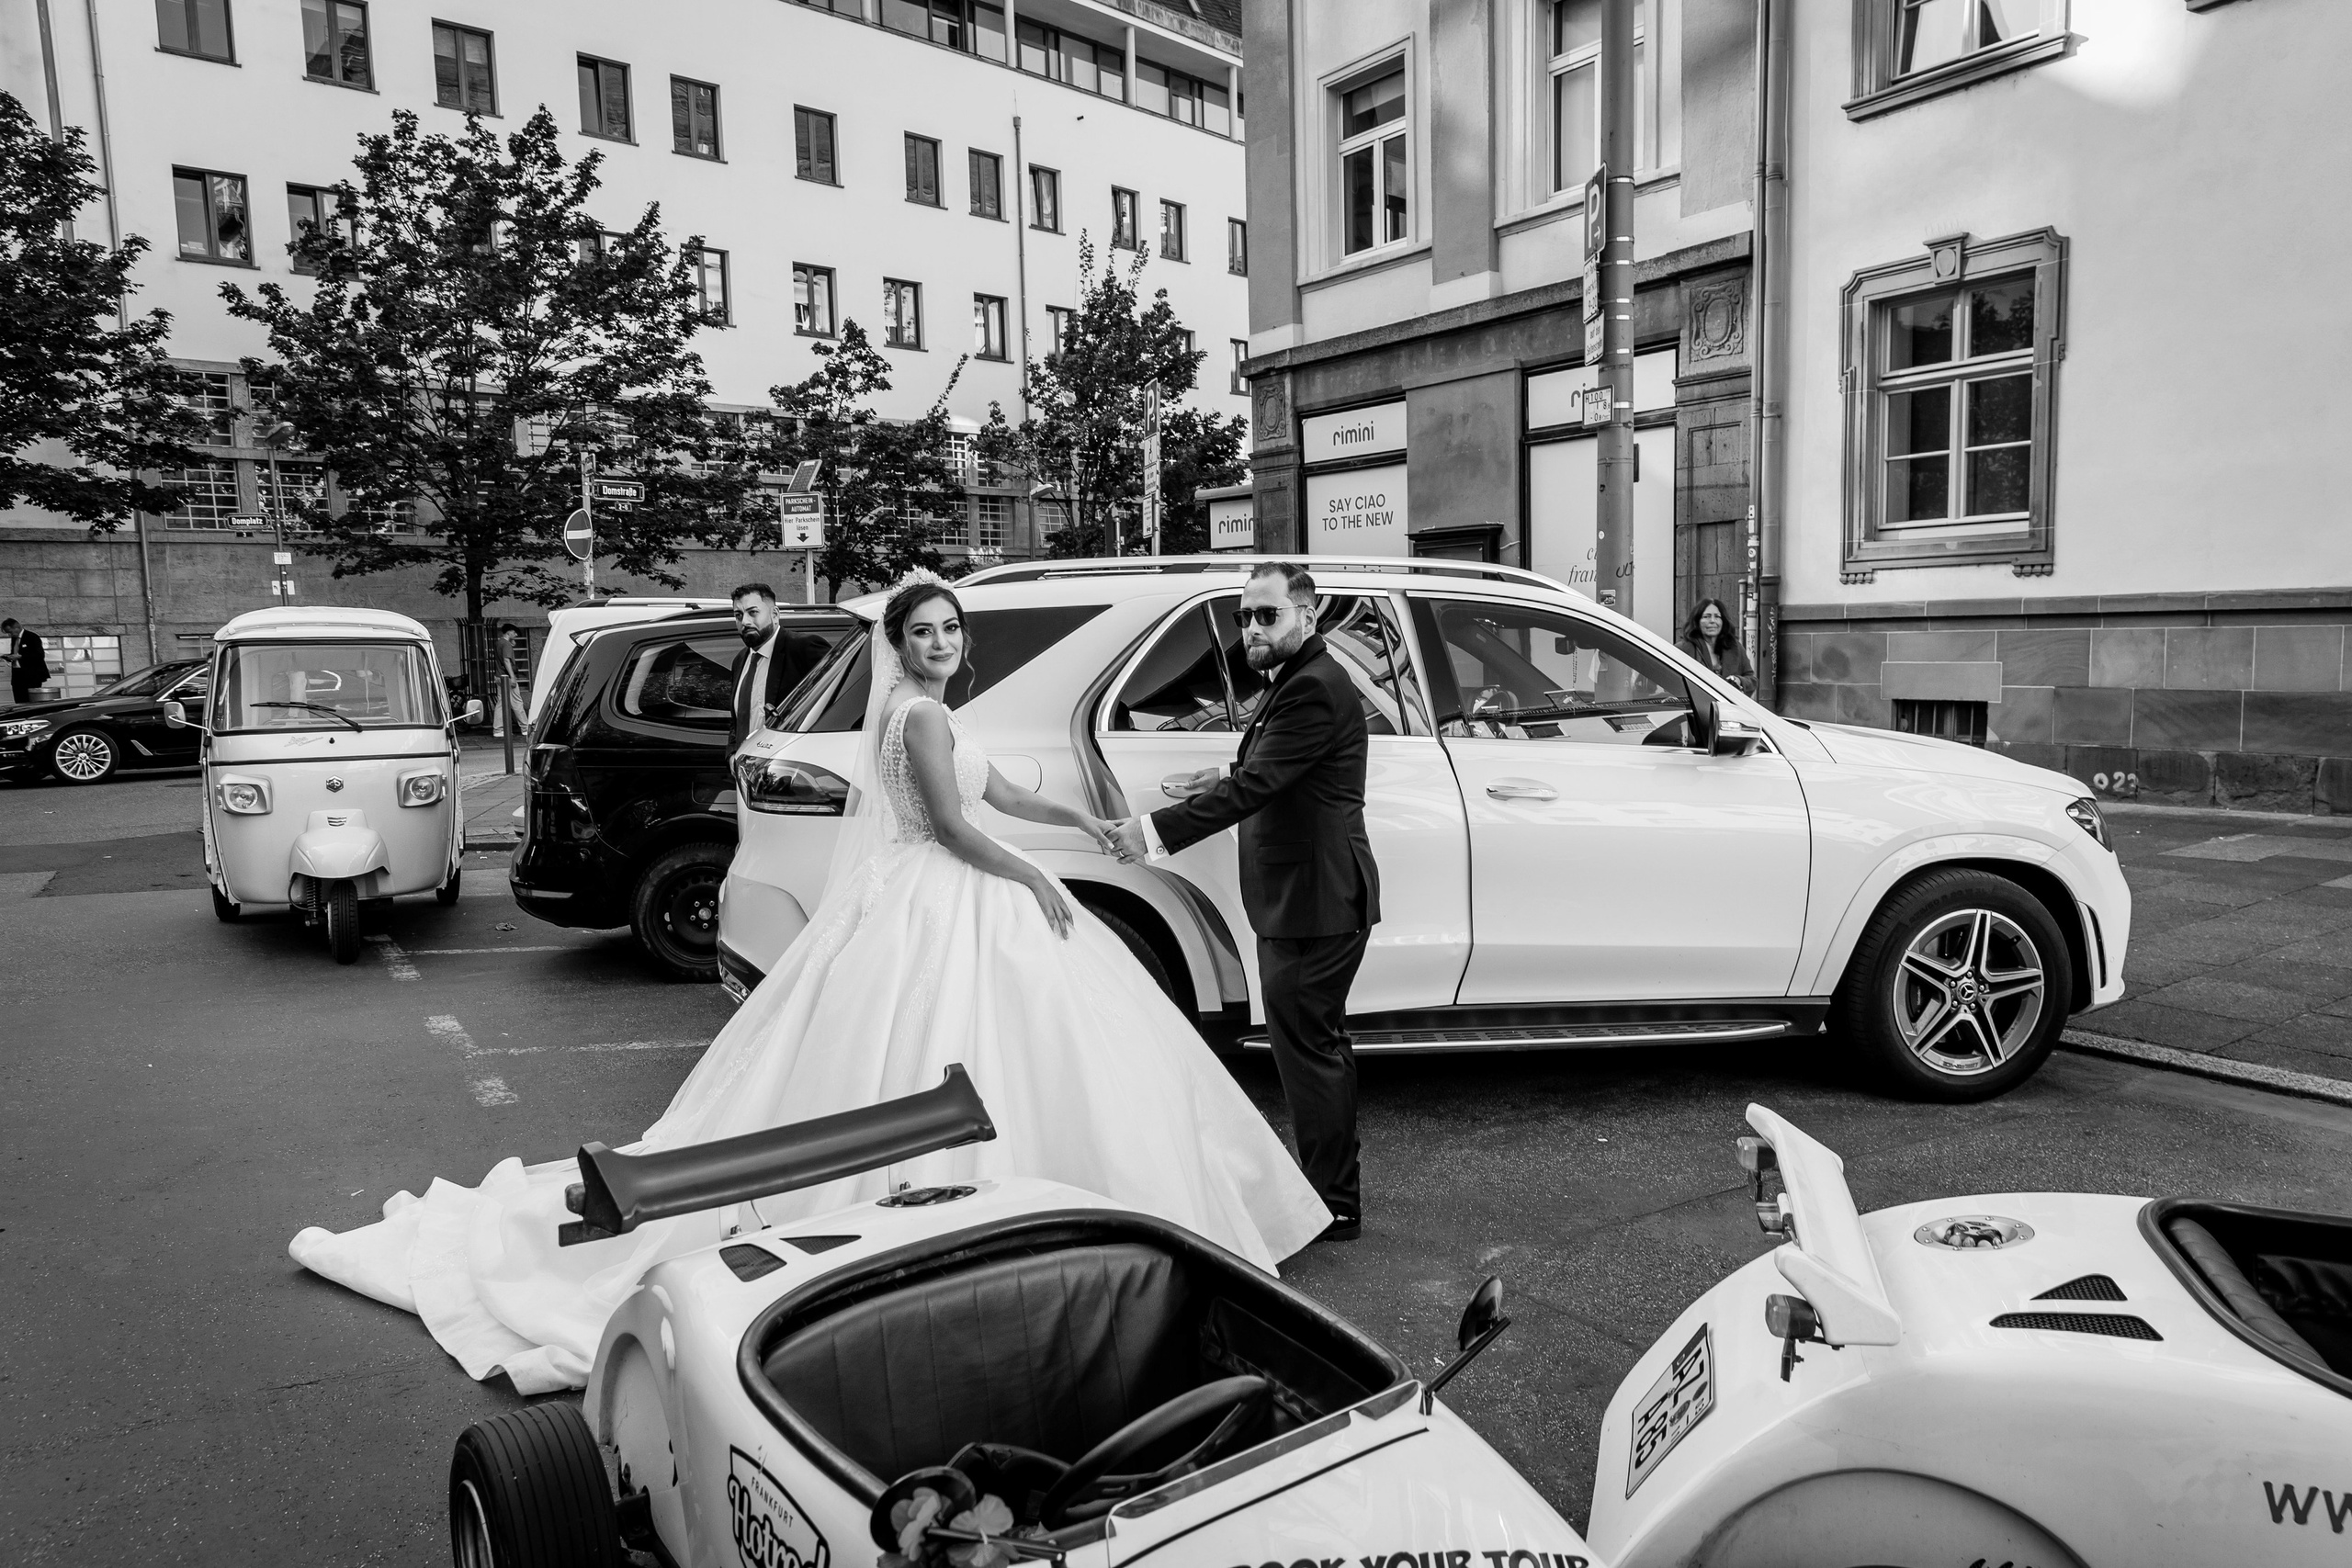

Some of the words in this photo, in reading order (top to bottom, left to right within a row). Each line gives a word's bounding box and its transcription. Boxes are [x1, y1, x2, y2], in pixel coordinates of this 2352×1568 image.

[1589, 184, 1600, 249] P
[1148, 389, 1155, 431] P
[1332, 420, 1374, 446] rimini
[602, 485, 638, 497] Domstraße
[1329, 497, 1351, 513] SAY
[1355, 493, 1385, 511] CIAO
[232, 517, 264, 526] Domplatz
[1322, 516, 1338, 532] TO
[1341, 514, 1362, 530] THE
[1365, 511, 1394, 527] NEW
[751, 1476, 794, 1529] FRANKFURT
